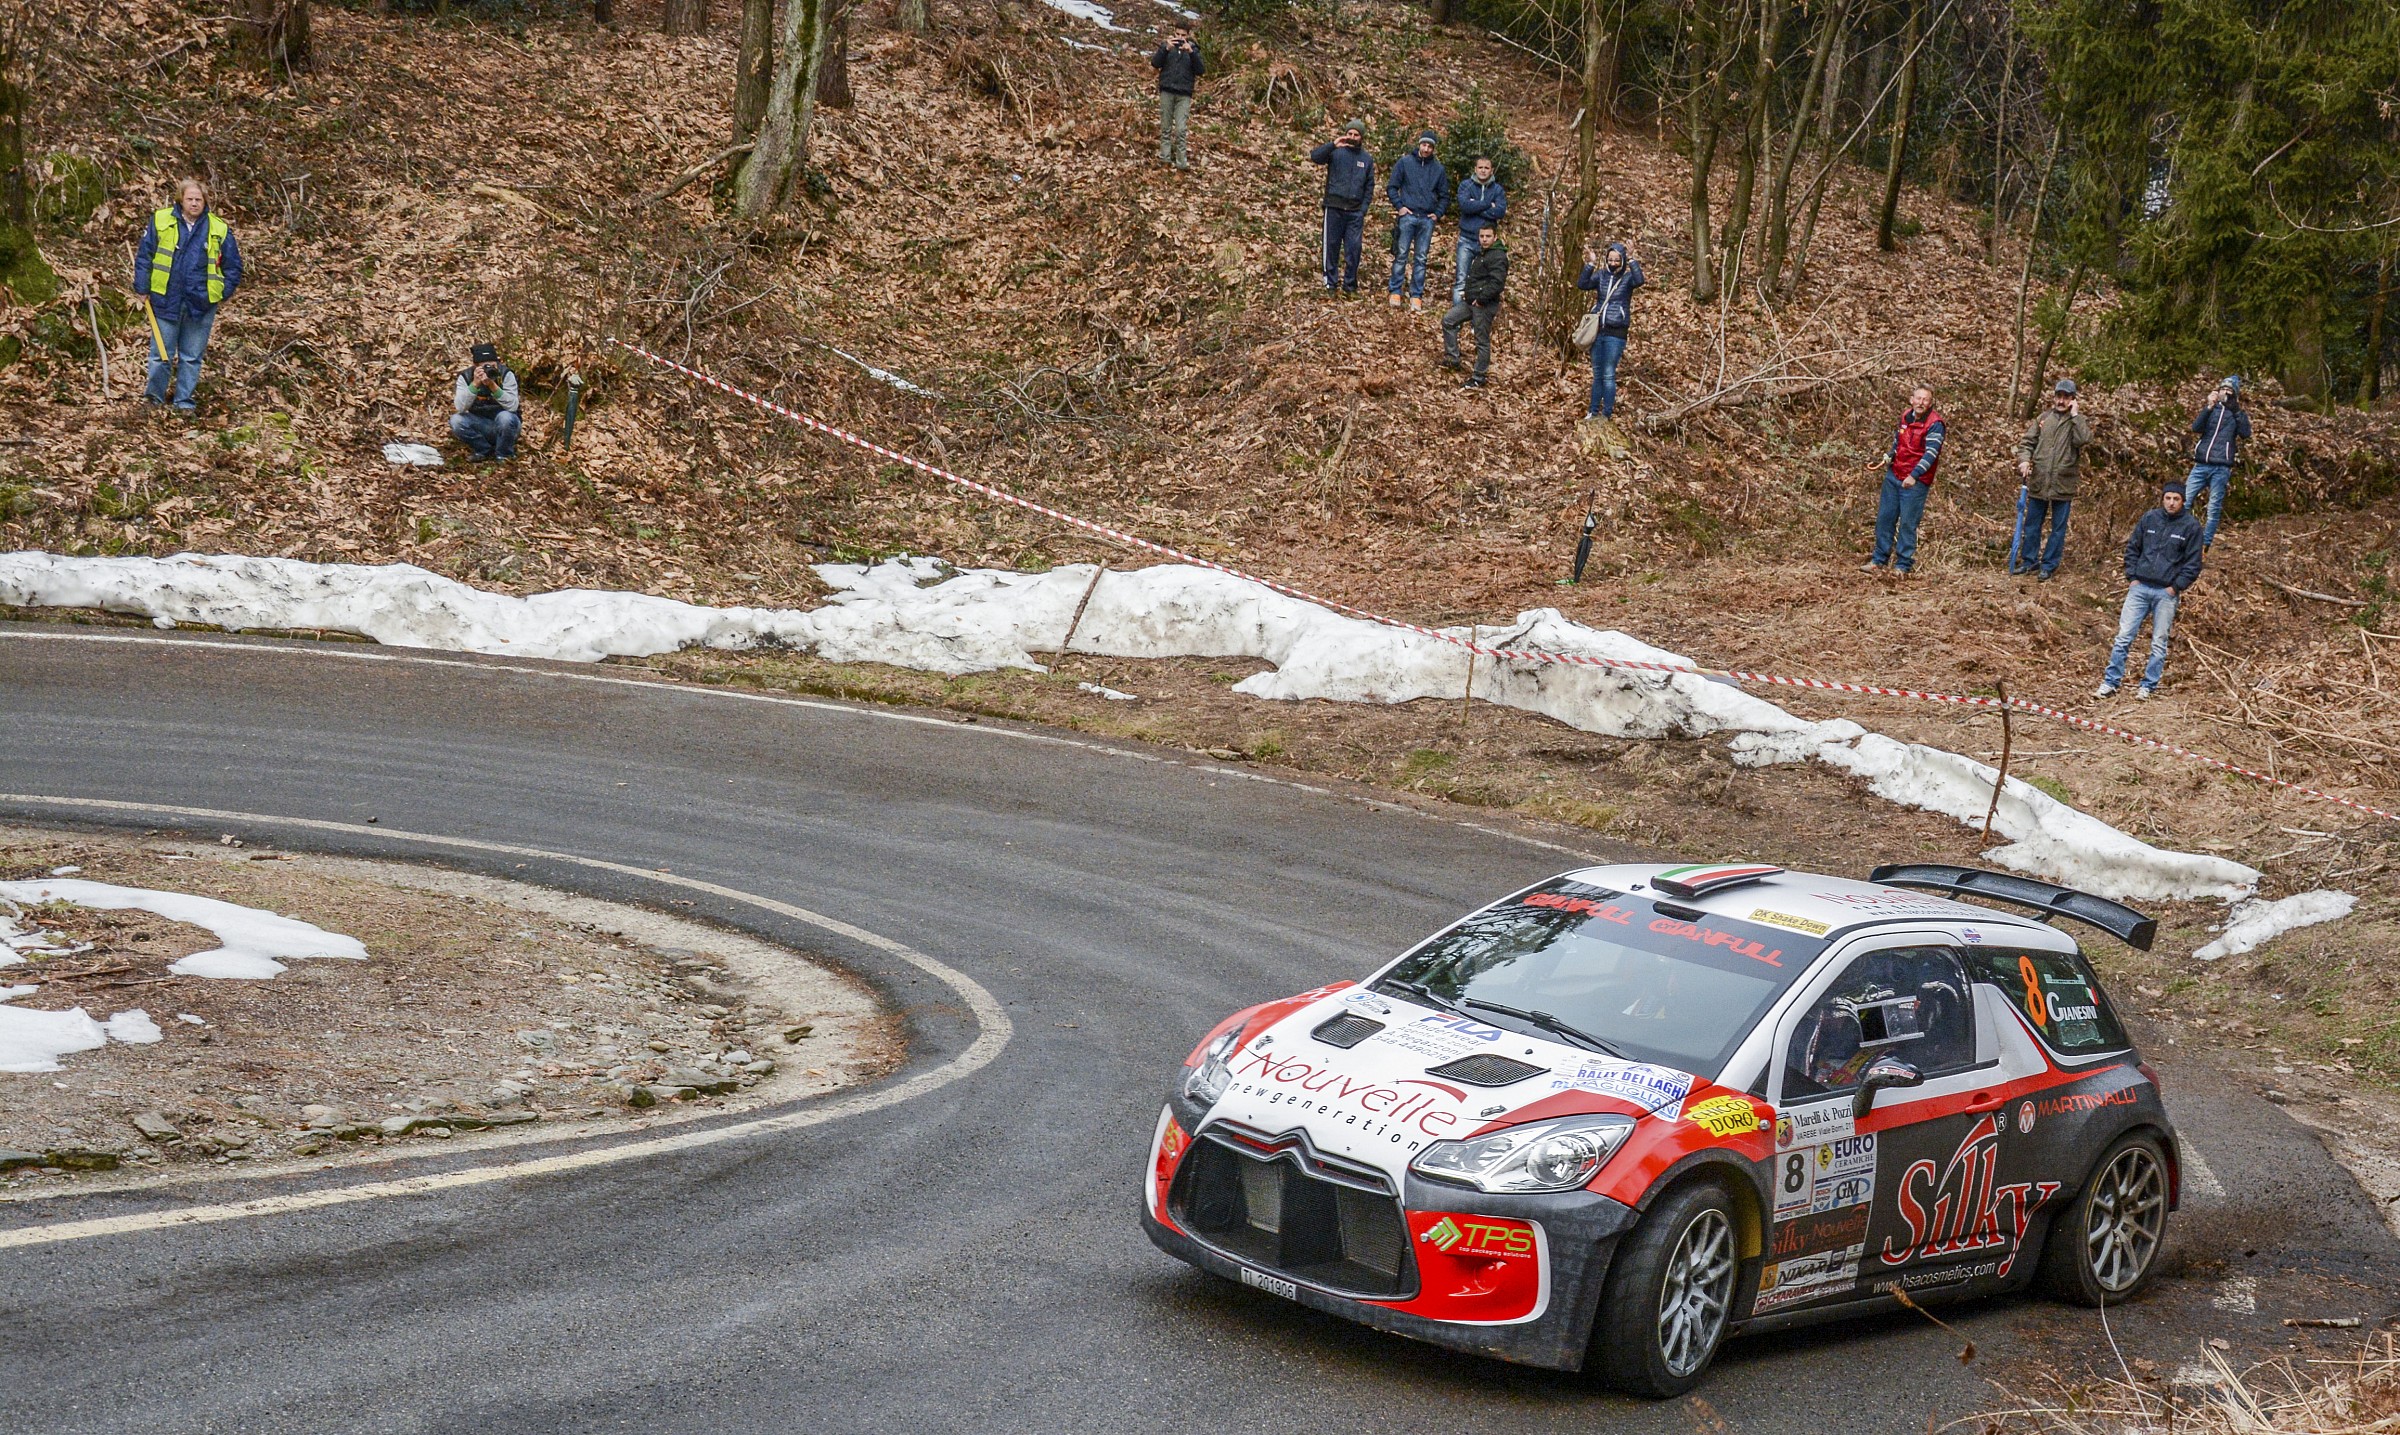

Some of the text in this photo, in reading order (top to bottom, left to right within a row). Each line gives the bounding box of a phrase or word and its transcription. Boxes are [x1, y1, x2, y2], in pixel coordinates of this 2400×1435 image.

[1754, 909, 1770, 918] OK
[1770, 912, 1798, 924] Shake
[1800, 919, 1827, 932] Down
[1648, 918, 1784, 968] GIANFULL
[2018, 955, 2047, 1027] 8
[1407, 1020, 1487, 1047] Underwear
[1420, 1013, 1503, 1042] FILA
[1236, 1051, 1458, 1137] Nouvelle
[1577, 1069, 1619, 1079] RALLY
[1621, 1071, 1646, 1083] DEI
[1647, 1078, 1687, 1099] LAGHI
[1691, 1100, 1750, 1120] CHICCO
[1793, 1104, 1853, 1128] Marelli & Pozzi
[2037, 1086, 2138, 1118] MARTINALLI
[1709, 1111, 1753, 1133] D'ORO
[1795, 1129, 1817, 1140] VARESE
[1834, 1133, 1875, 1160] EURO
[1834, 1153, 1875, 1169] CERAMICHE
[1784, 1153, 1805, 1194] 8
[1836, 1179, 1860, 1200] GM
[1881, 1111, 2062, 1279] Silky
[1463, 1223, 1535, 1252] TPS
[1243, 1269, 1295, 1299] TI 201906
